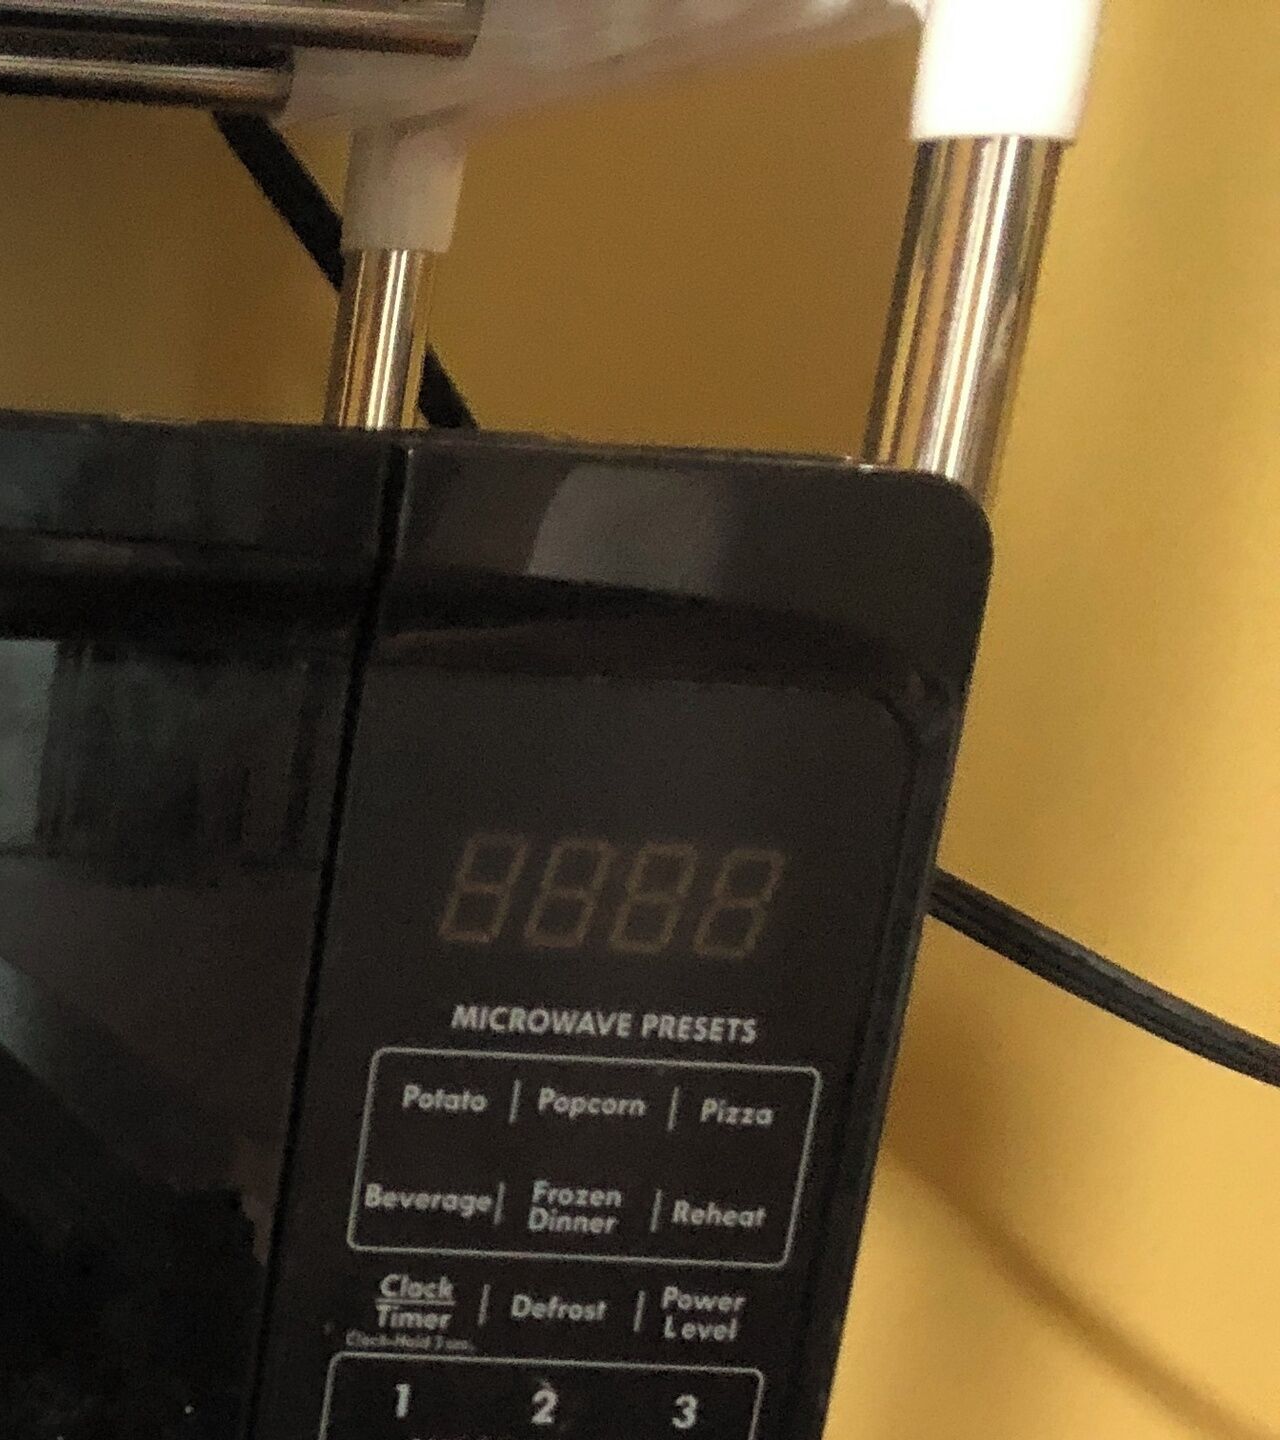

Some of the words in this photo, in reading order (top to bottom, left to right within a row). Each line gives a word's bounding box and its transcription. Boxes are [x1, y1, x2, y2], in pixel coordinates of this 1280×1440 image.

[451, 1004, 633, 1038] MICROWAVE
[640, 1013, 757, 1044] PRESETS
[401, 1083, 488, 1113] Potato
[537, 1086, 647, 1119] Popcorn
[700, 1097, 774, 1126] Pizza
[364, 1182, 492, 1219] Beverage
[531, 1179, 623, 1207] Frozen
[527, 1206, 621, 1234] Dinner
[671, 1199, 767, 1228] Reheat
[378, 1273, 454, 1299] Clock
[661, 1285, 746, 1313] Power
[375, 1305, 452, 1331] Timer
[510, 1293, 607, 1321] Defrost
[663, 1319, 738, 1343] Level
[395, 1383, 411, 1418] 1
[531, 1389, 559, 1425] 2
[672, 1394, 699, 1430] 3
